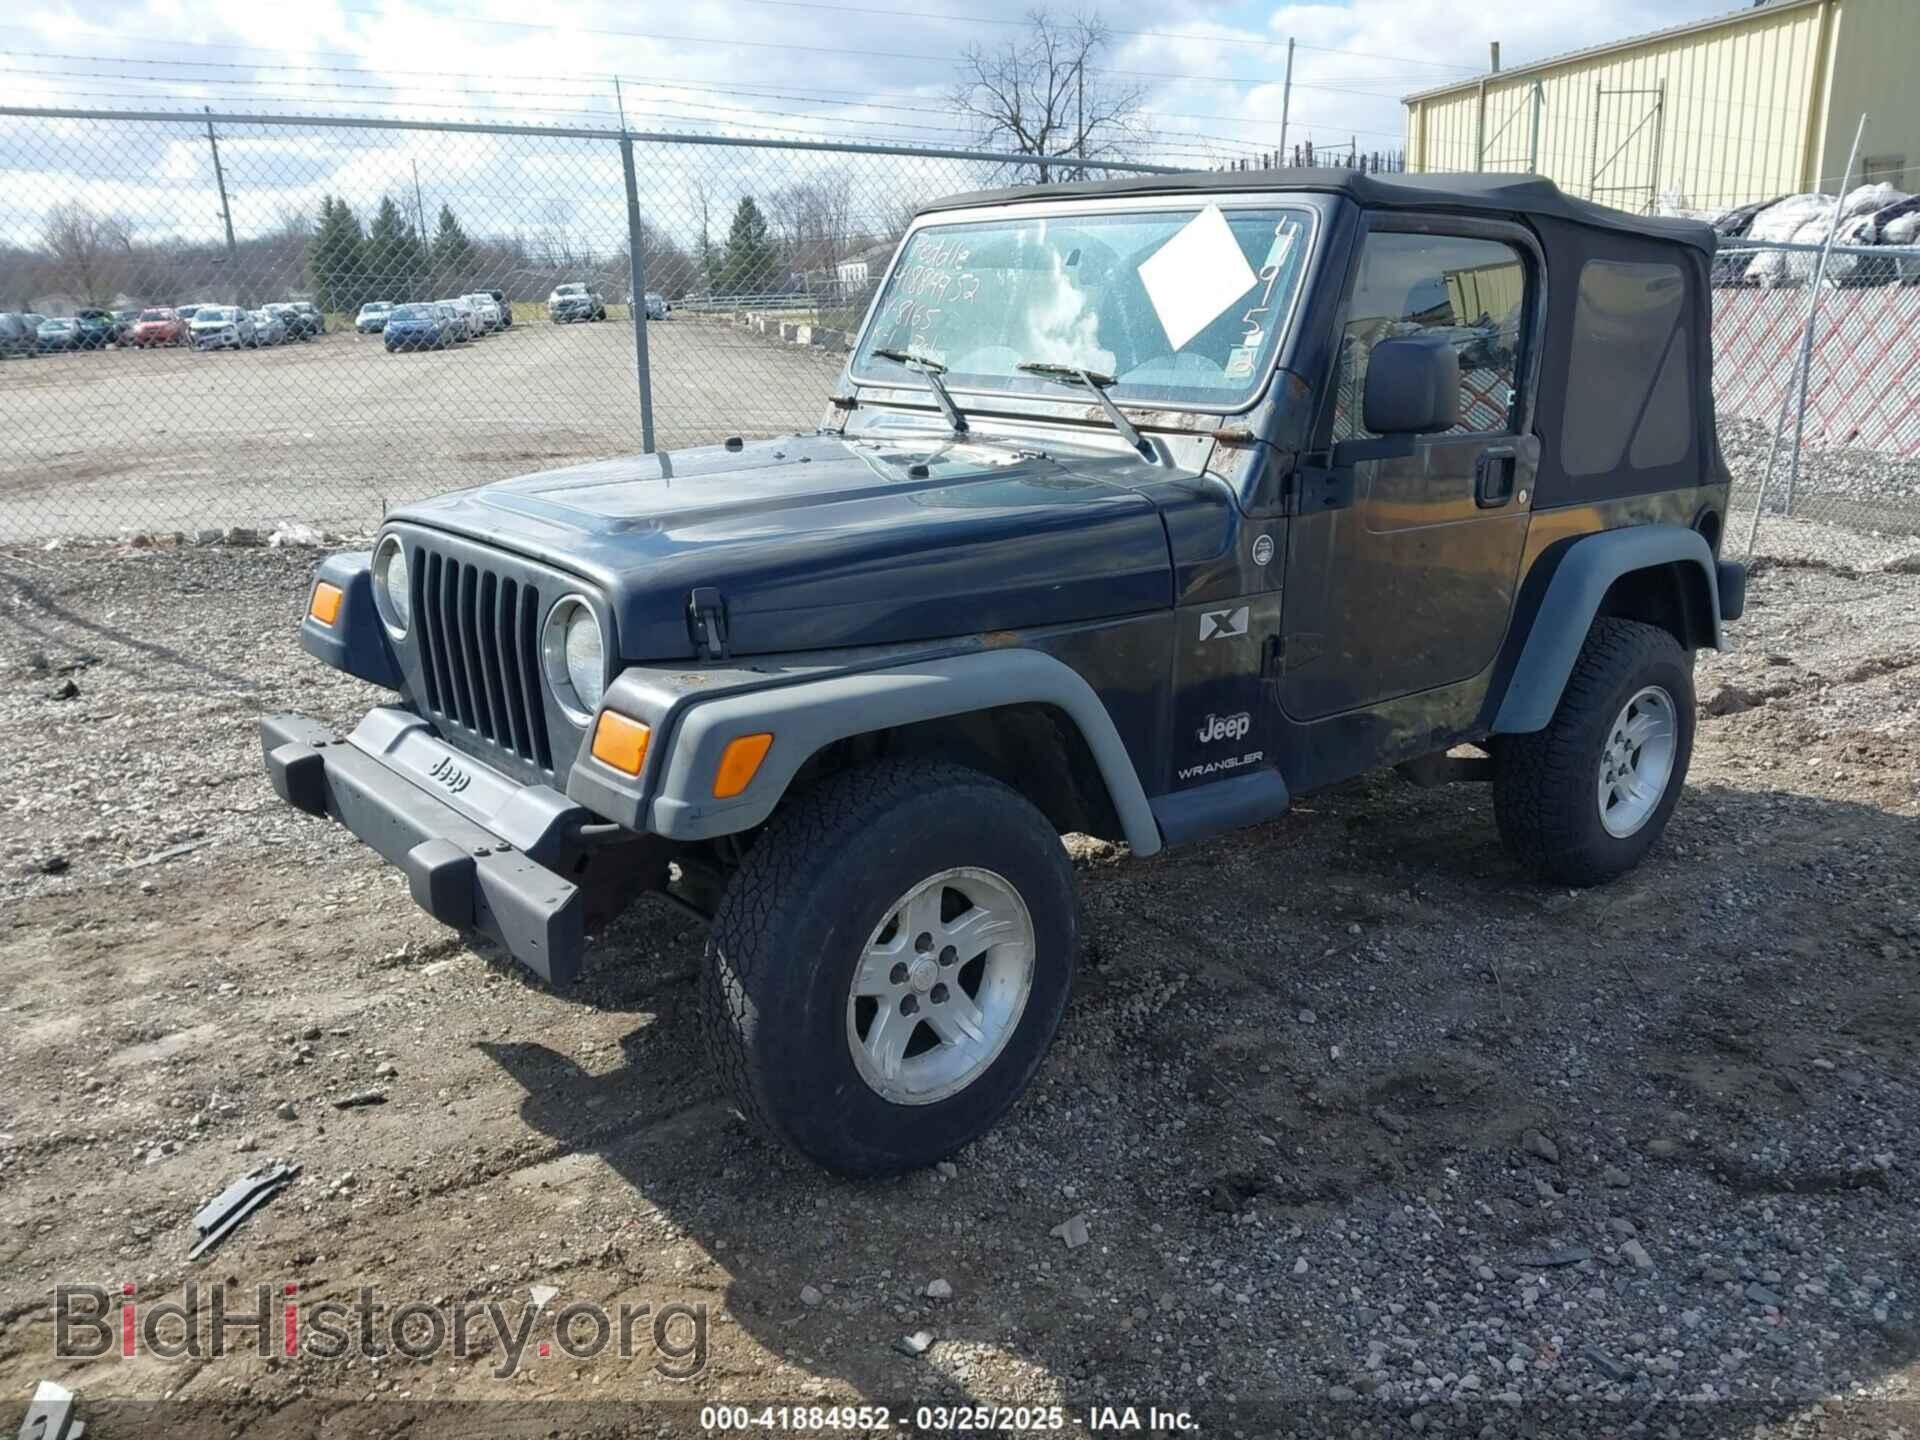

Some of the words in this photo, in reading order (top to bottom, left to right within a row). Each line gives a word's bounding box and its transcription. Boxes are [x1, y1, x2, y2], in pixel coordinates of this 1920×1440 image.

[1198, 713, 1251, 743] Jeep
[429, 756, 472, 794] Jeep
[1178, 751, 1264, 780] WRANGLER
